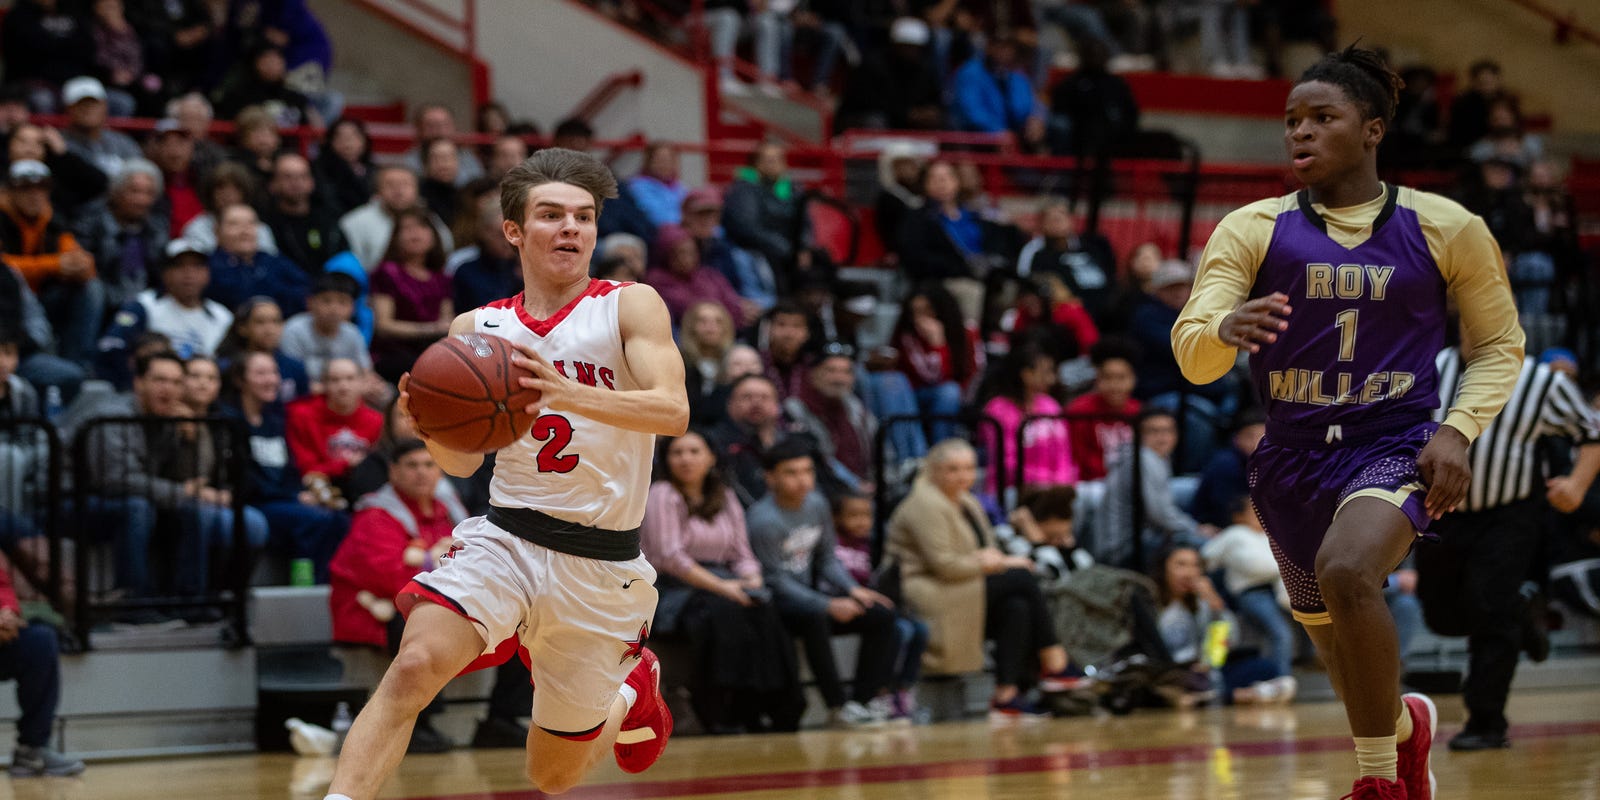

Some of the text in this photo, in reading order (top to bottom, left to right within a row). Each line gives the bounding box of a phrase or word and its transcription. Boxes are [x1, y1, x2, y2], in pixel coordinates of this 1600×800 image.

[1306, 263, 1395, 300] ROY
[1335, 309, 1359, 361] 1
[1269, 368, 1415, 406] MILLER
[531, 414, 576, 473] 2
